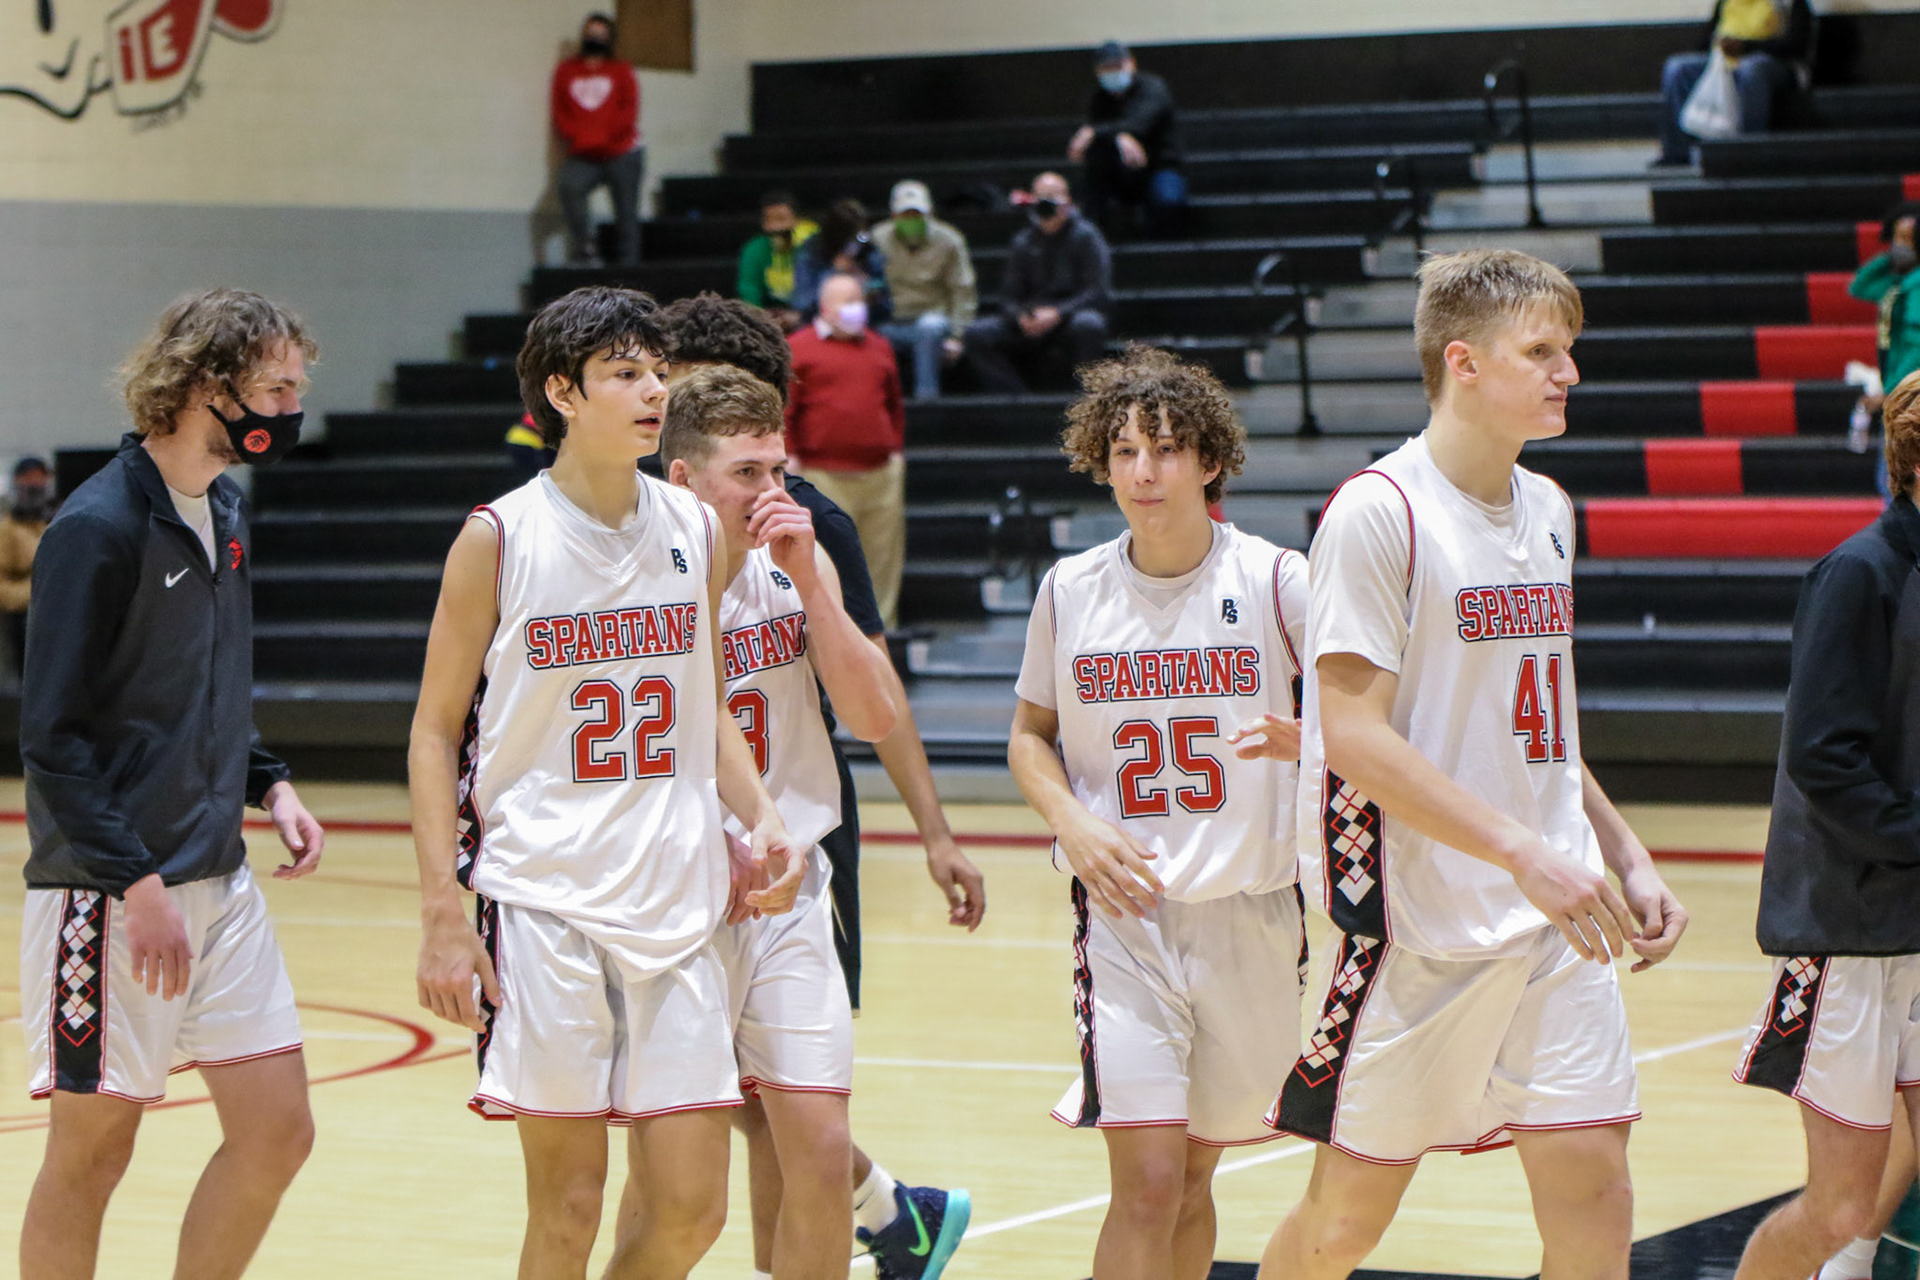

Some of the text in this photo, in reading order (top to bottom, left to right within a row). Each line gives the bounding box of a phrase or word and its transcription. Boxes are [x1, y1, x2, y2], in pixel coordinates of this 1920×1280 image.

[525, 602, 697, 670] SPARTANS
[722, 611, 806, 682] RTANS
[1072, 647, 1261, 704] SPARTANS
[571, 675, 677, 783] 22
[1512, 653, 1567, 763] 41
[1112, 716, 1227, 819] 25
